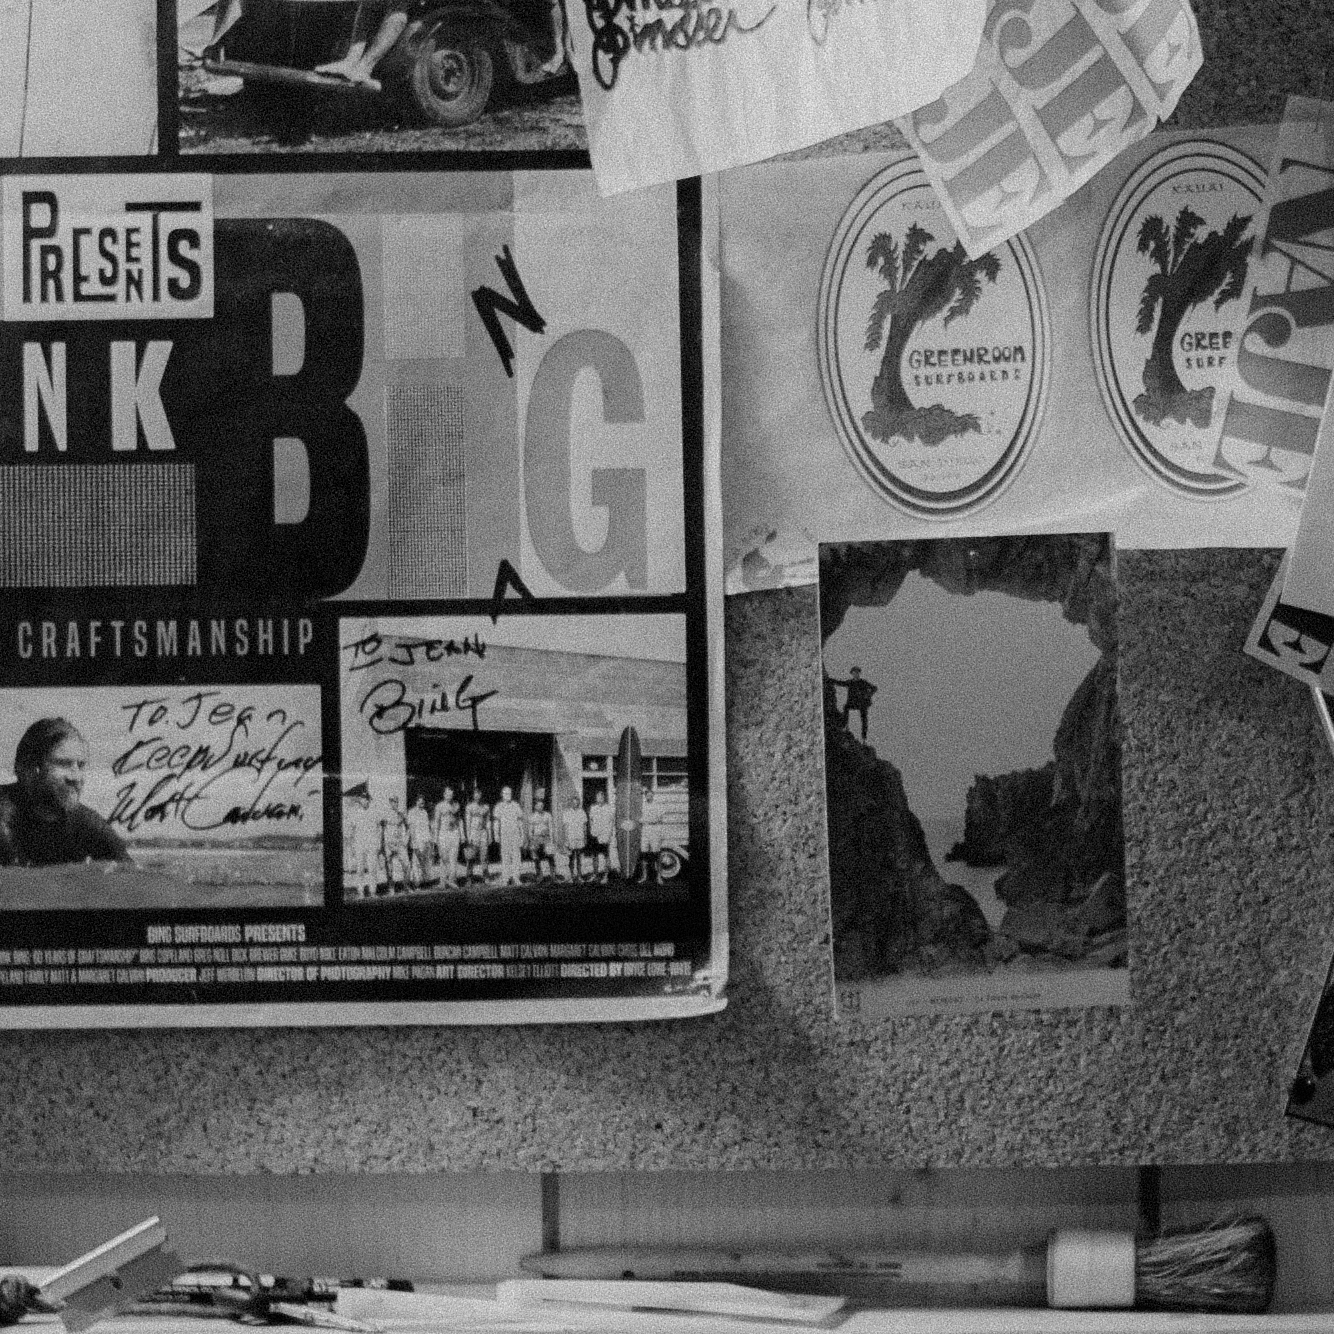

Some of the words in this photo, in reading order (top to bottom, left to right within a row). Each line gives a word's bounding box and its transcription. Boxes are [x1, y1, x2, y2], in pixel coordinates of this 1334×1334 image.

[910, 77, 1040, 229] JE
[22, 190, 202, 303] PRESENTS
[909, 345, 1026, 369] GREENROOM
[1185, 355, 1227, 369] SURF
[913, 372, 1022, 387] SURFBOARDS
[18, 617, 314, 659] CRAFTSMANSHIP
[147, 925, 172, 943] BING
[174, 924, 241, 943] SURFBOARDS
[244, 922, 305, 942] PRESENTS
